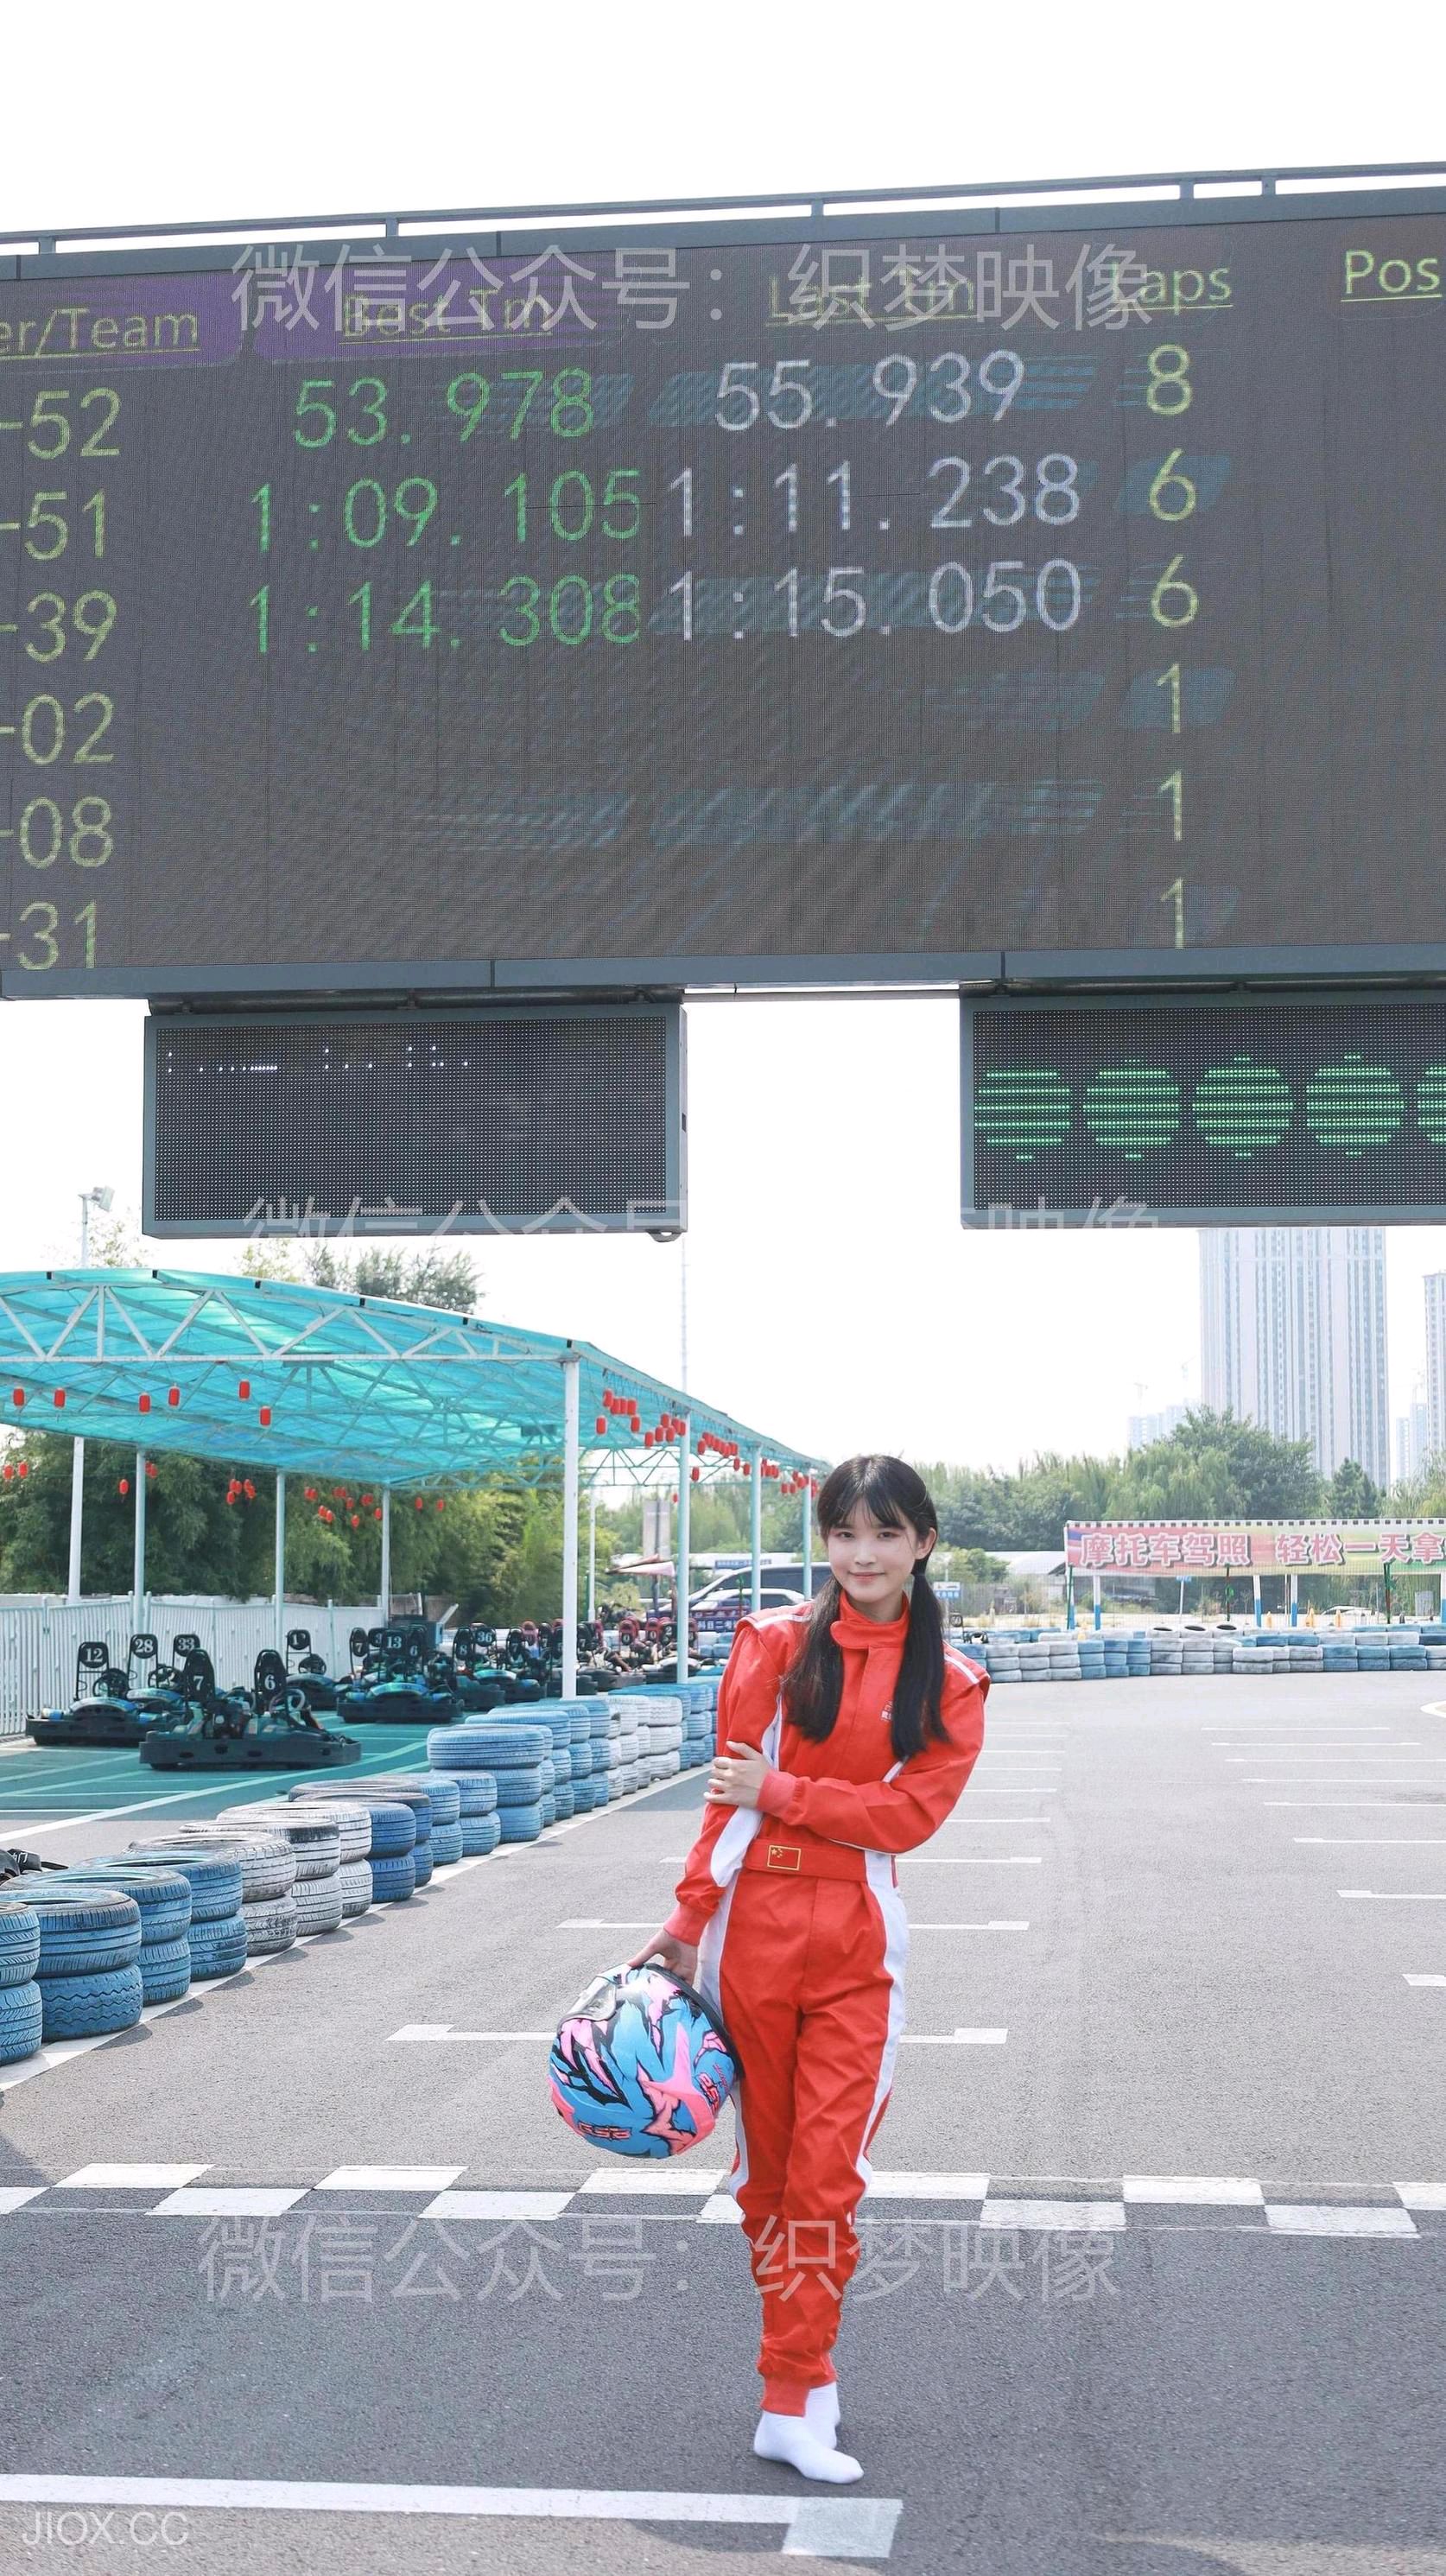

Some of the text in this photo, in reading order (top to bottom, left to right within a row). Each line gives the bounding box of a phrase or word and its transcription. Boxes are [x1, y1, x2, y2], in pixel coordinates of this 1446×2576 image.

[1111, 261, 1233, 316] Laps
[1344, 249, 1441, 295] Pos
[1145, 343, 1195, 416] 8
[1148, 447, 1198, 522] 6
[1150, 553, 1201, 629] 6
[1156, 663, 1180, 734] 1
[1158, 770, 1183, 842] 1
[1160, 878, 1184, 950] 1
[1080, 1531, 1444, 1568] 摩托车驾照 轻松一天拿
[85, 1647, 104, 1663] 12
[135, 1638, 154, 1653] 28
[177, 1638, 195, 1652] 33
[387, 1635, 403, 1650] 13
[477, 1630, 493, 1643] 36
[193, 1675, 205, 1691] 7
[264, 1675, 276, 1691] 6
